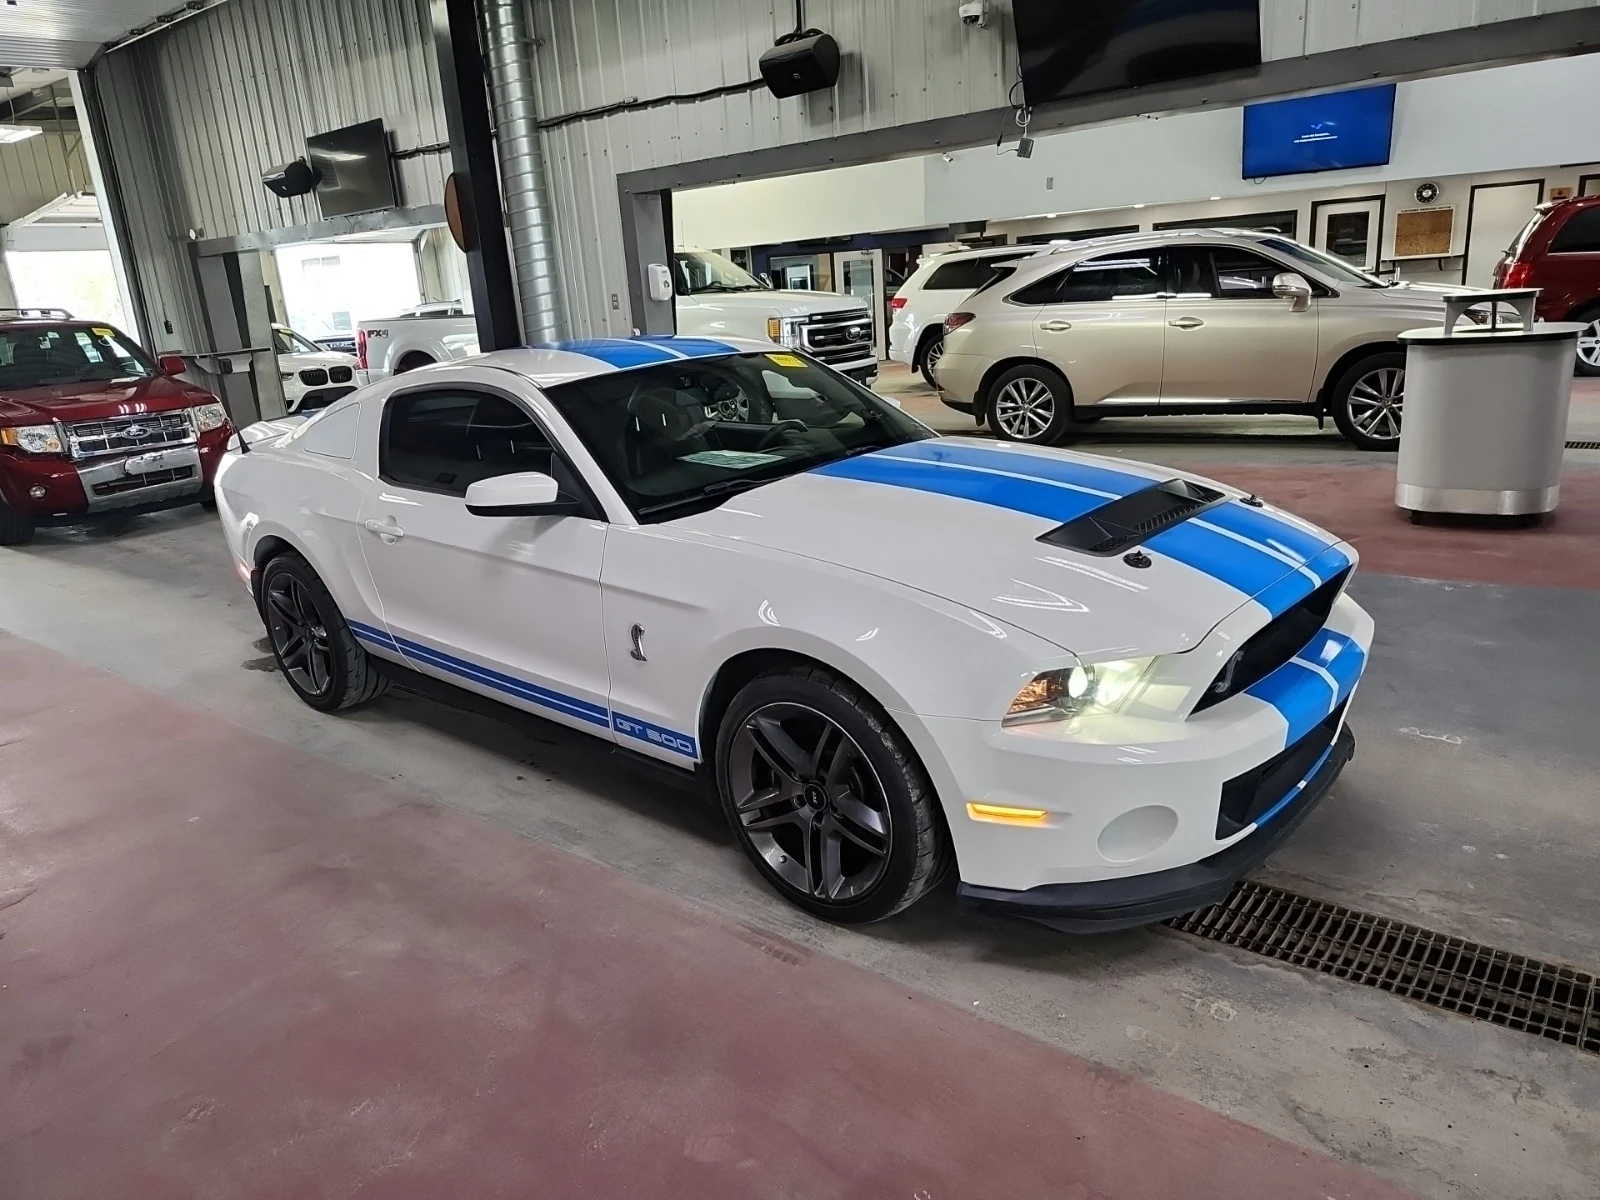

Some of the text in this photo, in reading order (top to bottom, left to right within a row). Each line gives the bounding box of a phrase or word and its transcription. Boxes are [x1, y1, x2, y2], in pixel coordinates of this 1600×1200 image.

[367, 329, 388, 338] FX4
[616, 717, 693, 753] GT 500
